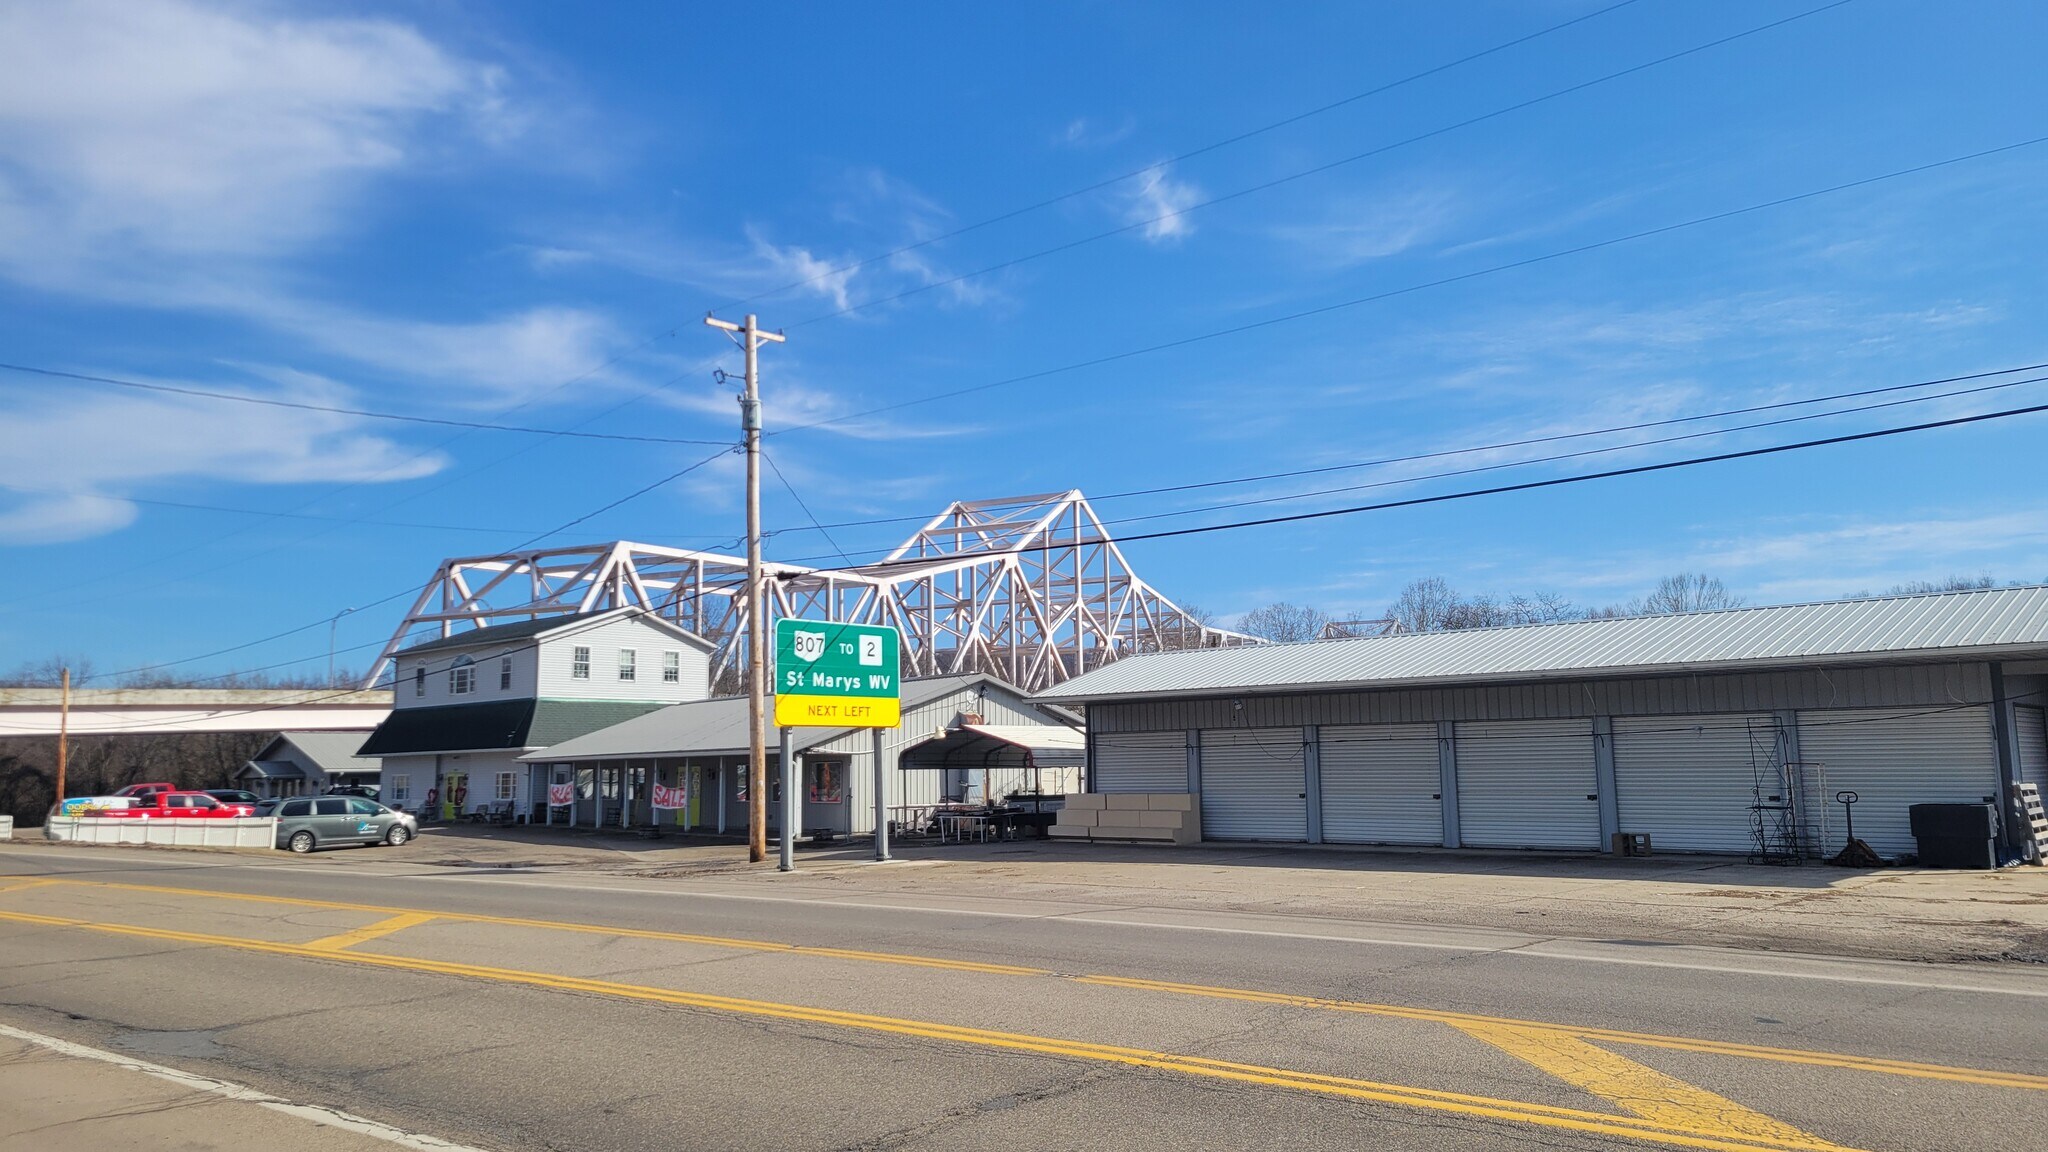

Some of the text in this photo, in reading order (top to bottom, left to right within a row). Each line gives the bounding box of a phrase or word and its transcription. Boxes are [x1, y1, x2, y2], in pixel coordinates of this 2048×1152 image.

[795, 636, 876, 657] 807 TO 2
[786, 671, 890, 692] St Marys WV
[808, 705, 871, 717] NEXT LEFT
[654, 785, 685, 807] SALE
